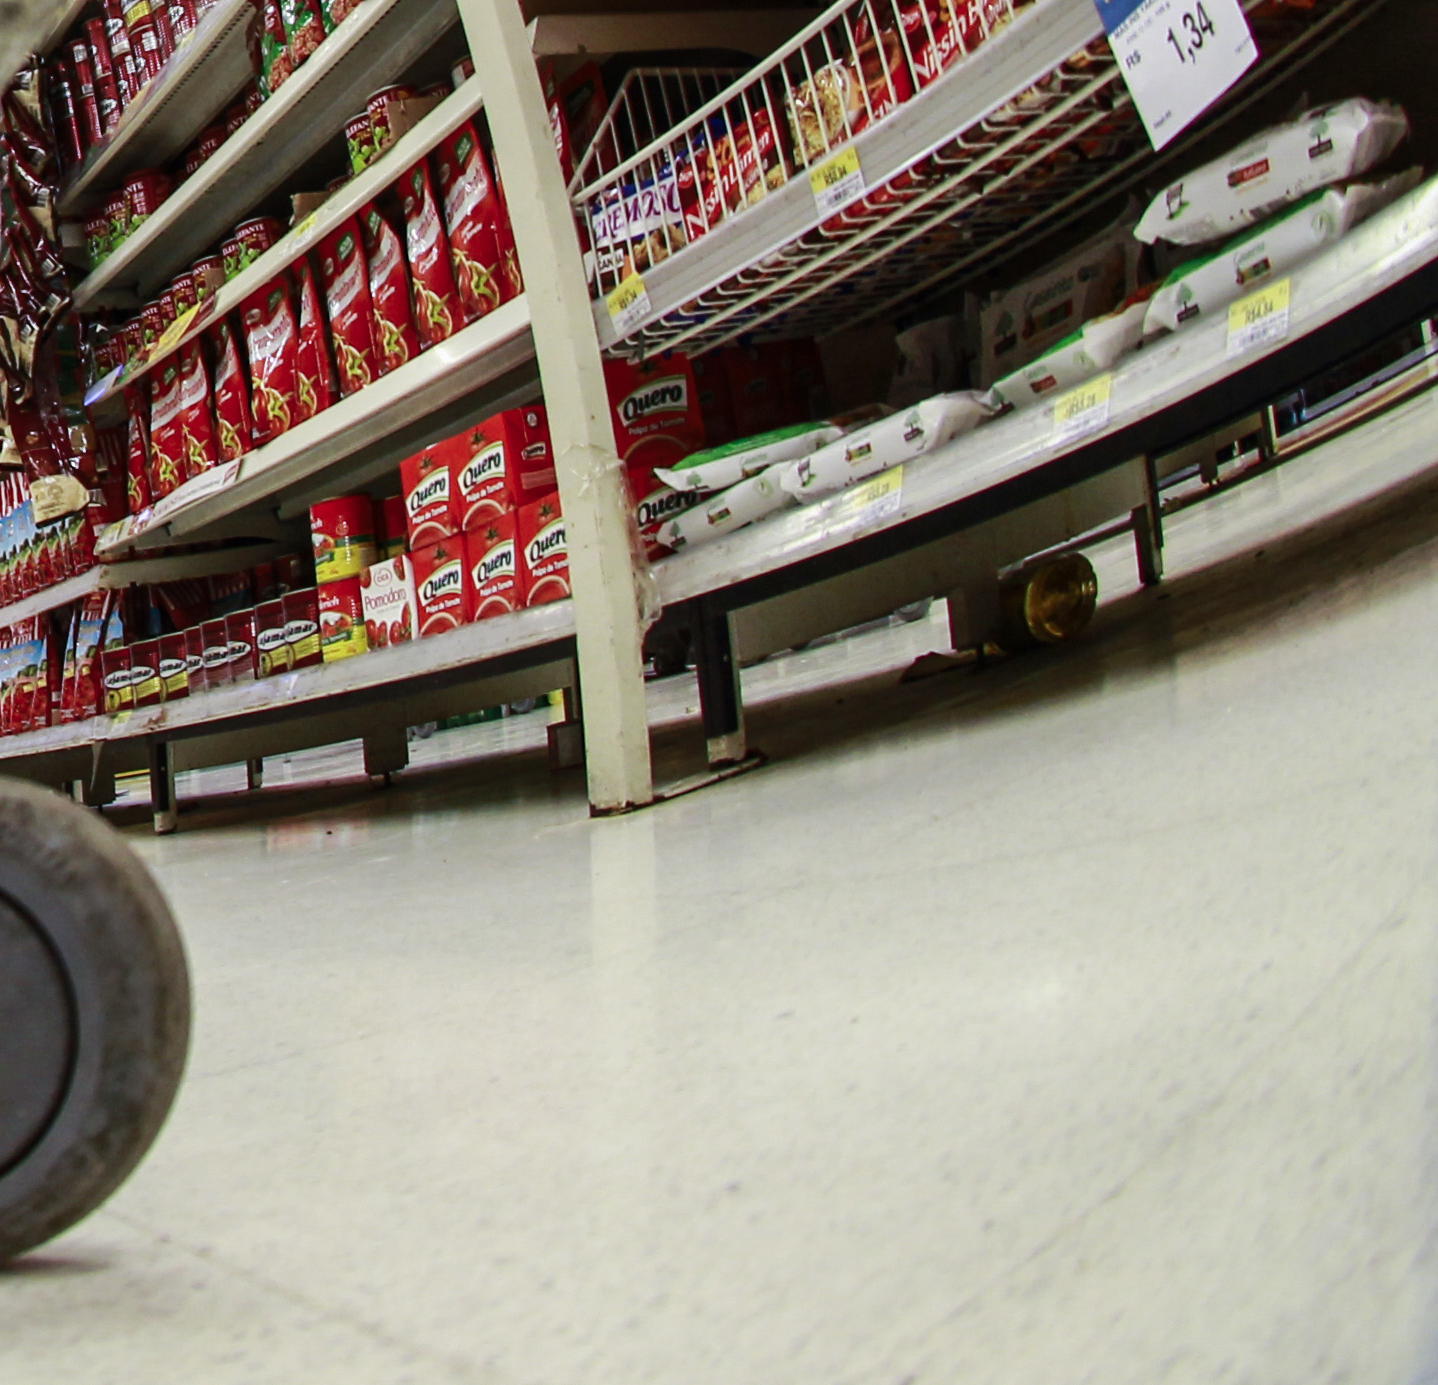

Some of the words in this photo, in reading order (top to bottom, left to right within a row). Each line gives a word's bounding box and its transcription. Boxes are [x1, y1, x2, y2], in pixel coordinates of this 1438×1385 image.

[1166, 0, 1215, 66] 1,34
[623, 383, 683, 420] Quero
[462, 451, 501, 489] Quero
[410, 477, 446, 512] Quero
[637, 493, 698, 527] Quero
[529, 528, 566, 562] Quer
[477, 549, 512, 584] Quero
[364, 586, 407, 611] Pomodoro
[422, 570, 459, 602] Quero
